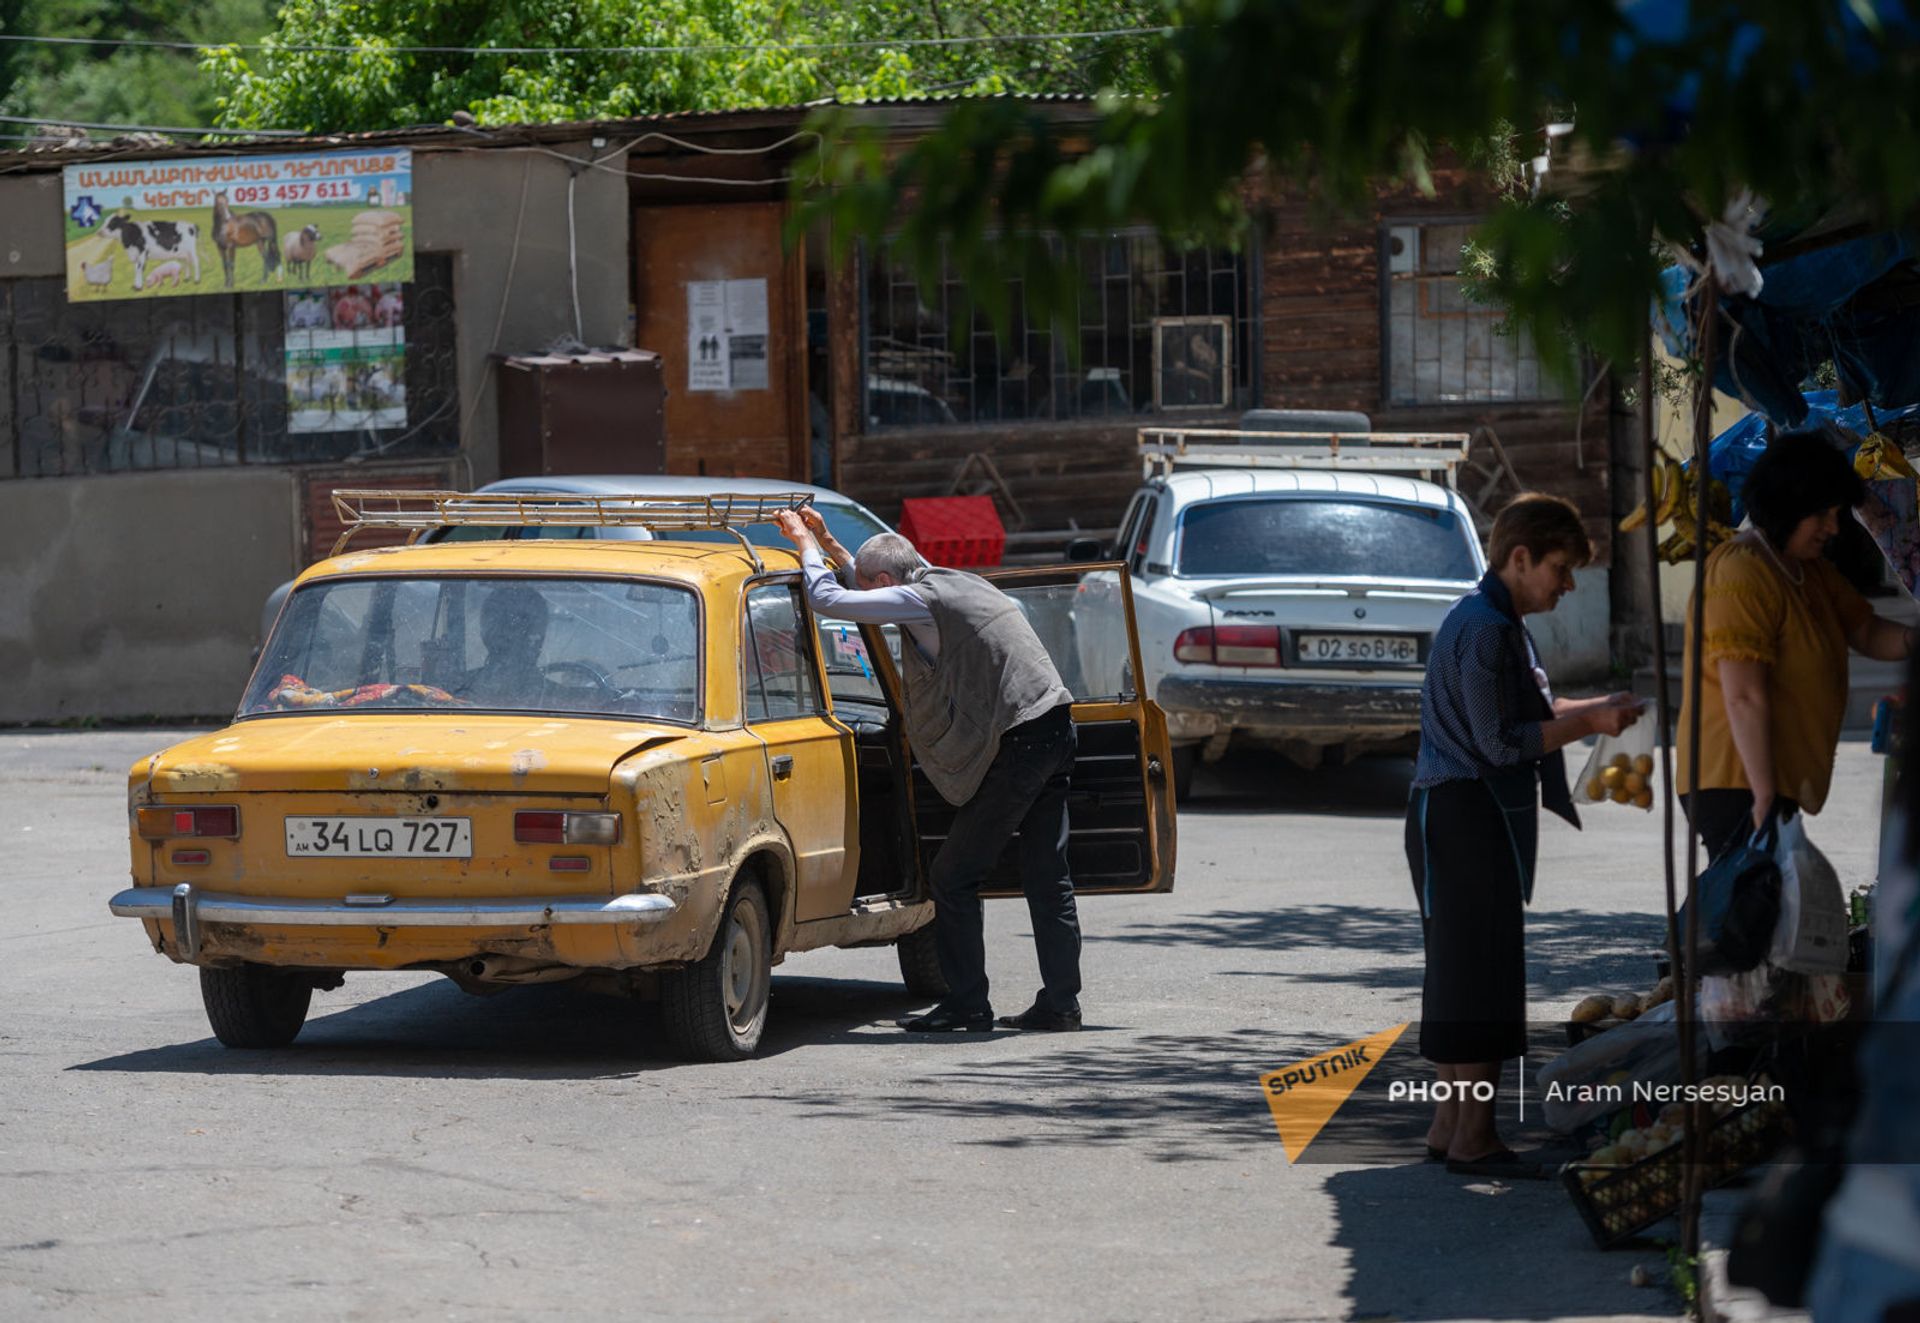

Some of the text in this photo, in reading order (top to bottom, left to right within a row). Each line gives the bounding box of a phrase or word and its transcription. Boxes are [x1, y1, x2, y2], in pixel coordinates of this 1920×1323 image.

[143, 181, 351, 207] ԿԵՐԵՐ 093 457 611
[1317, 638, 1342, 658] 02
[295, 822, 458, 853] AM 34 LQ 727
